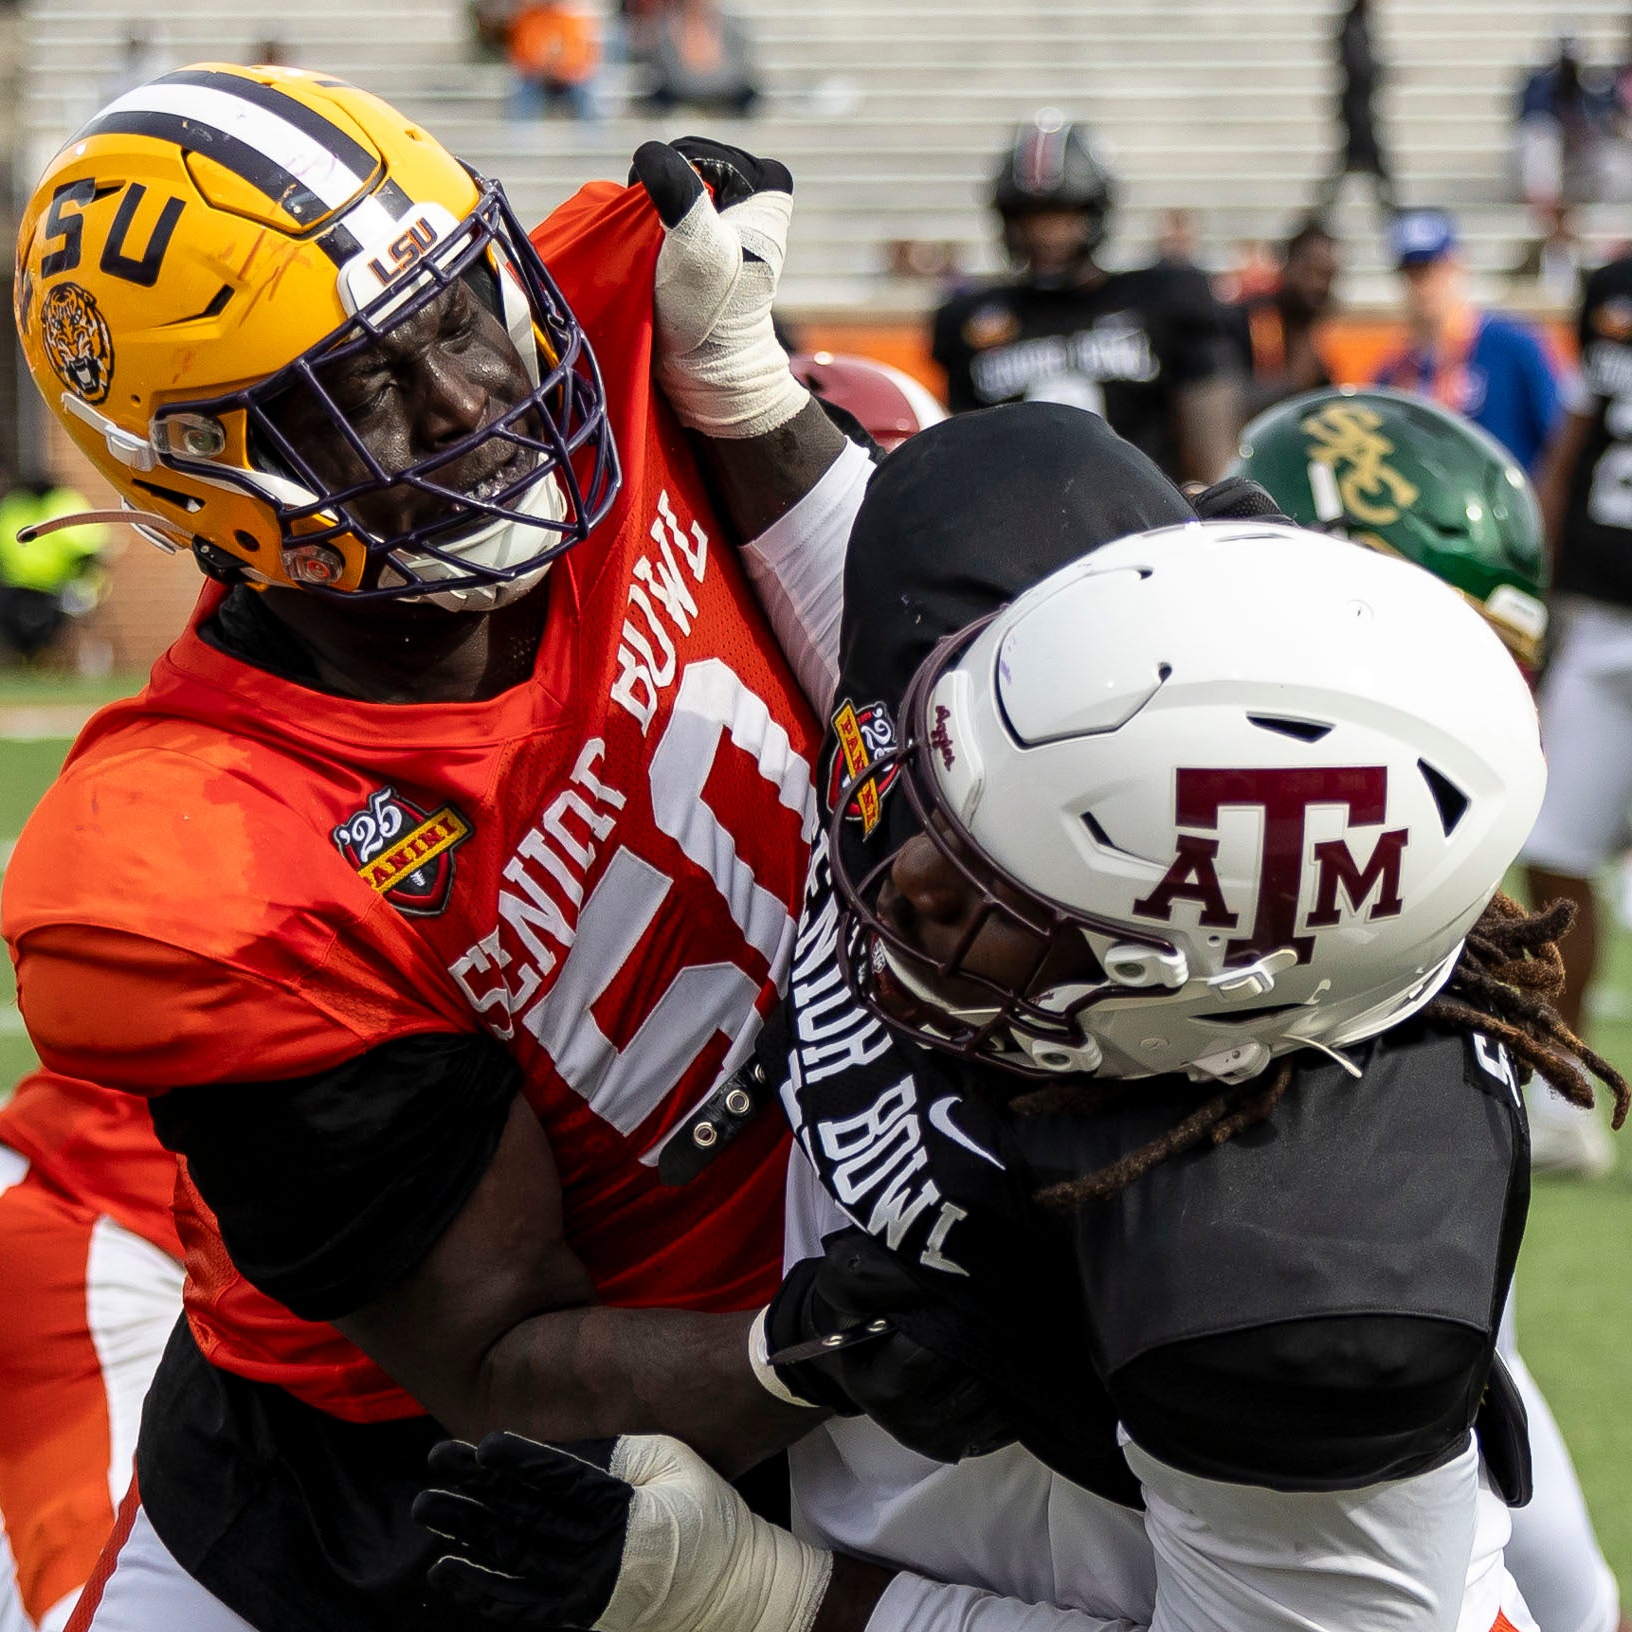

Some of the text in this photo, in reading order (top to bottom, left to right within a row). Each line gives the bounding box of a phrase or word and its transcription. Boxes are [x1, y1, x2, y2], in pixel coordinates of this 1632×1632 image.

[368, 216, 438, 287] LSU
[610, 489, 709, 738] BOWL
[338, 787, 403, 863] '25
[840, 714, 877, 825] PANNI
[521, 655, 819, 1168] 50
[818, 1074, 970, 1277] BOWL
